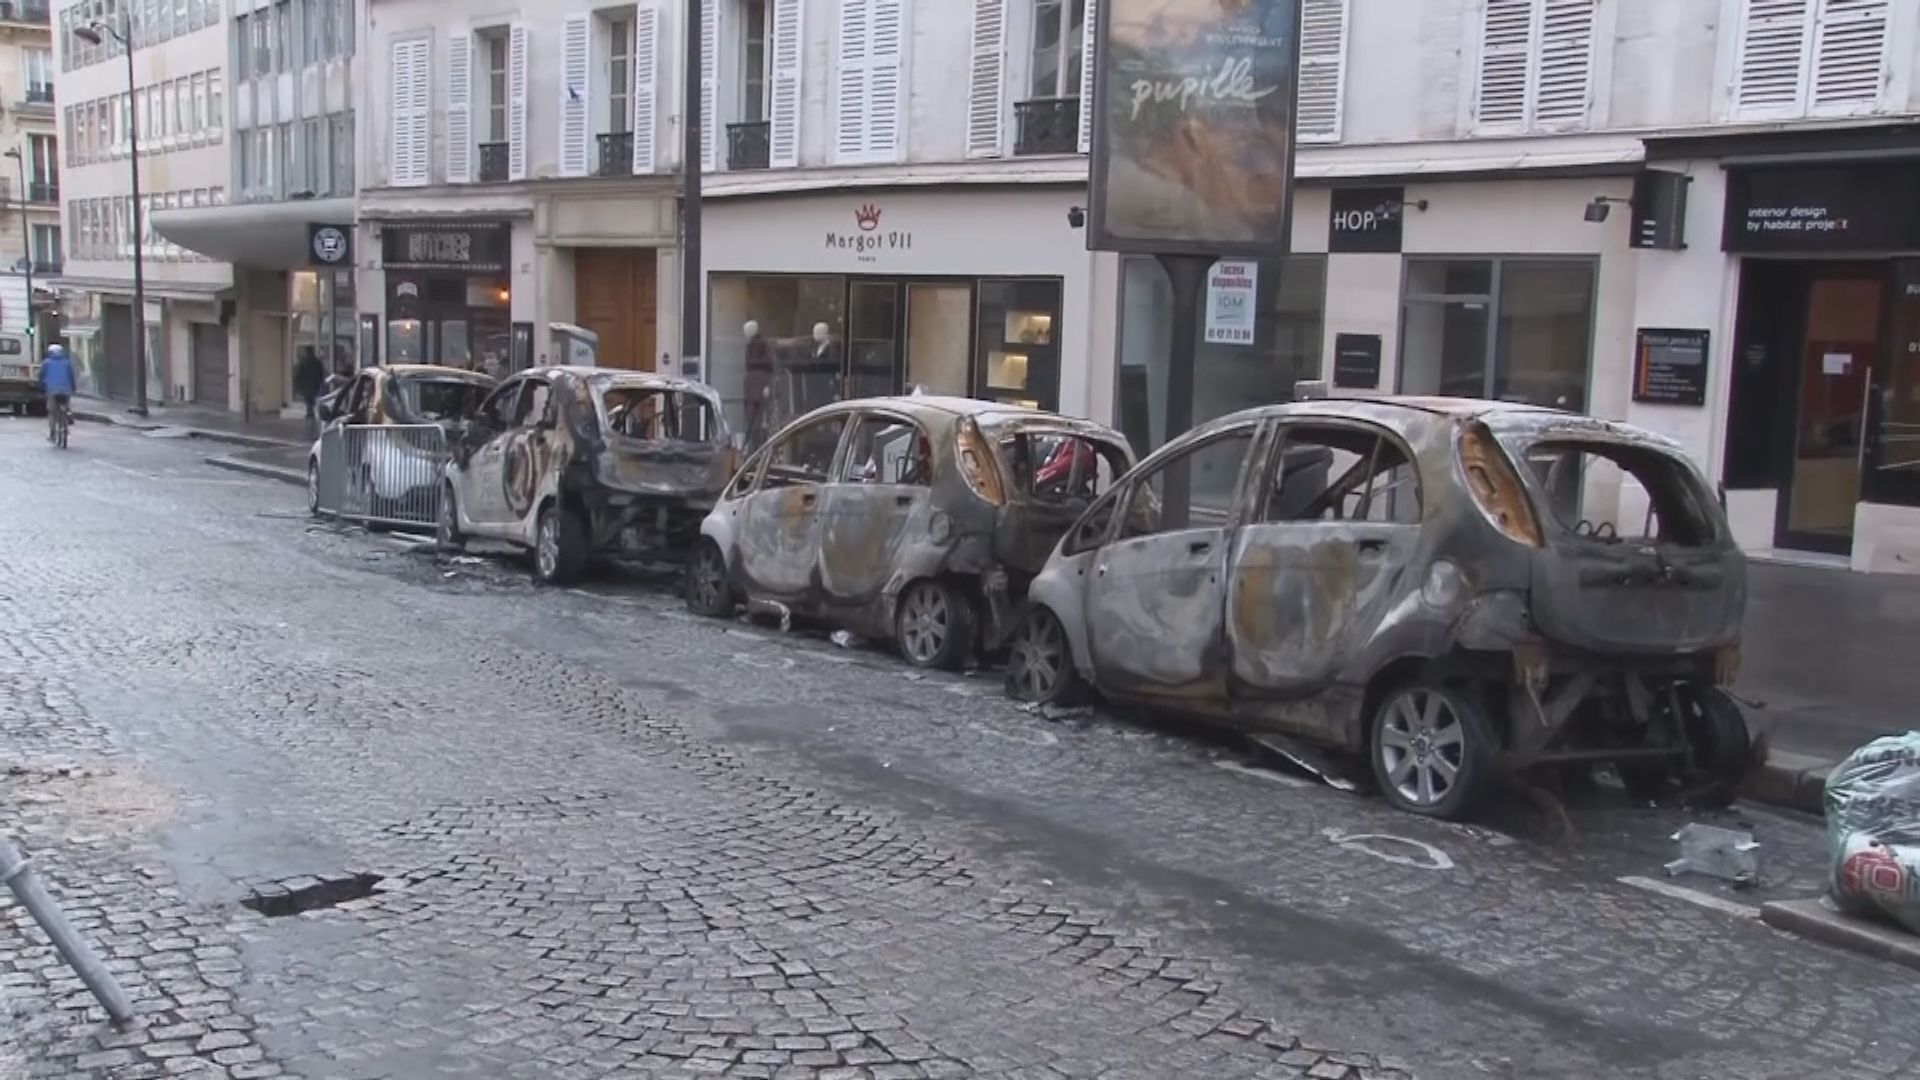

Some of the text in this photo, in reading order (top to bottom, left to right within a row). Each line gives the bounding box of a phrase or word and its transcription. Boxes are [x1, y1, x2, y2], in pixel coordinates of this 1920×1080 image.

[1131, 56, 1278, 121] pupille
[1748, 206, 1827, 219] interior design
[1747, 219, 1848, 232] by habitat project
[825, 231, 912, 252] Margot VII
